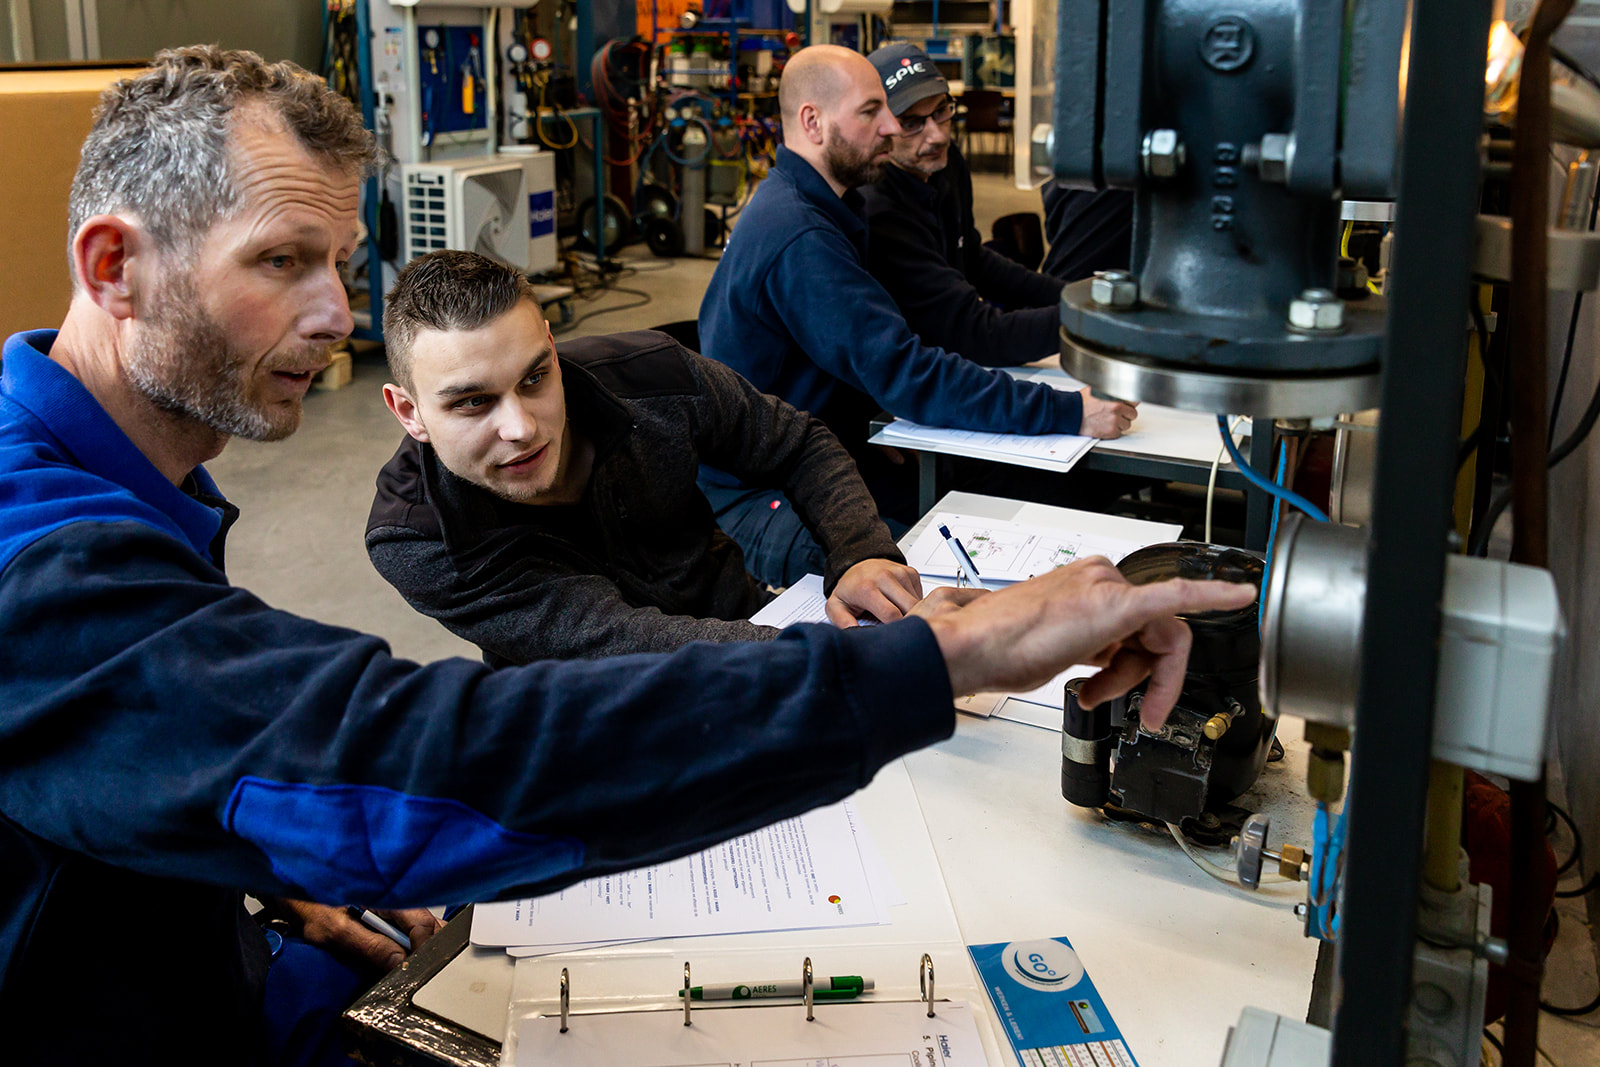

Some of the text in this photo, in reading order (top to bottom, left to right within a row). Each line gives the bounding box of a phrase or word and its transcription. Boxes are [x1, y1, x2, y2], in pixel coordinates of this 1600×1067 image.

[885, 58, 926, 90] SPIE
[752, 985, 777, 994] AERES
[939, 1035, 952, 1058] Haier
